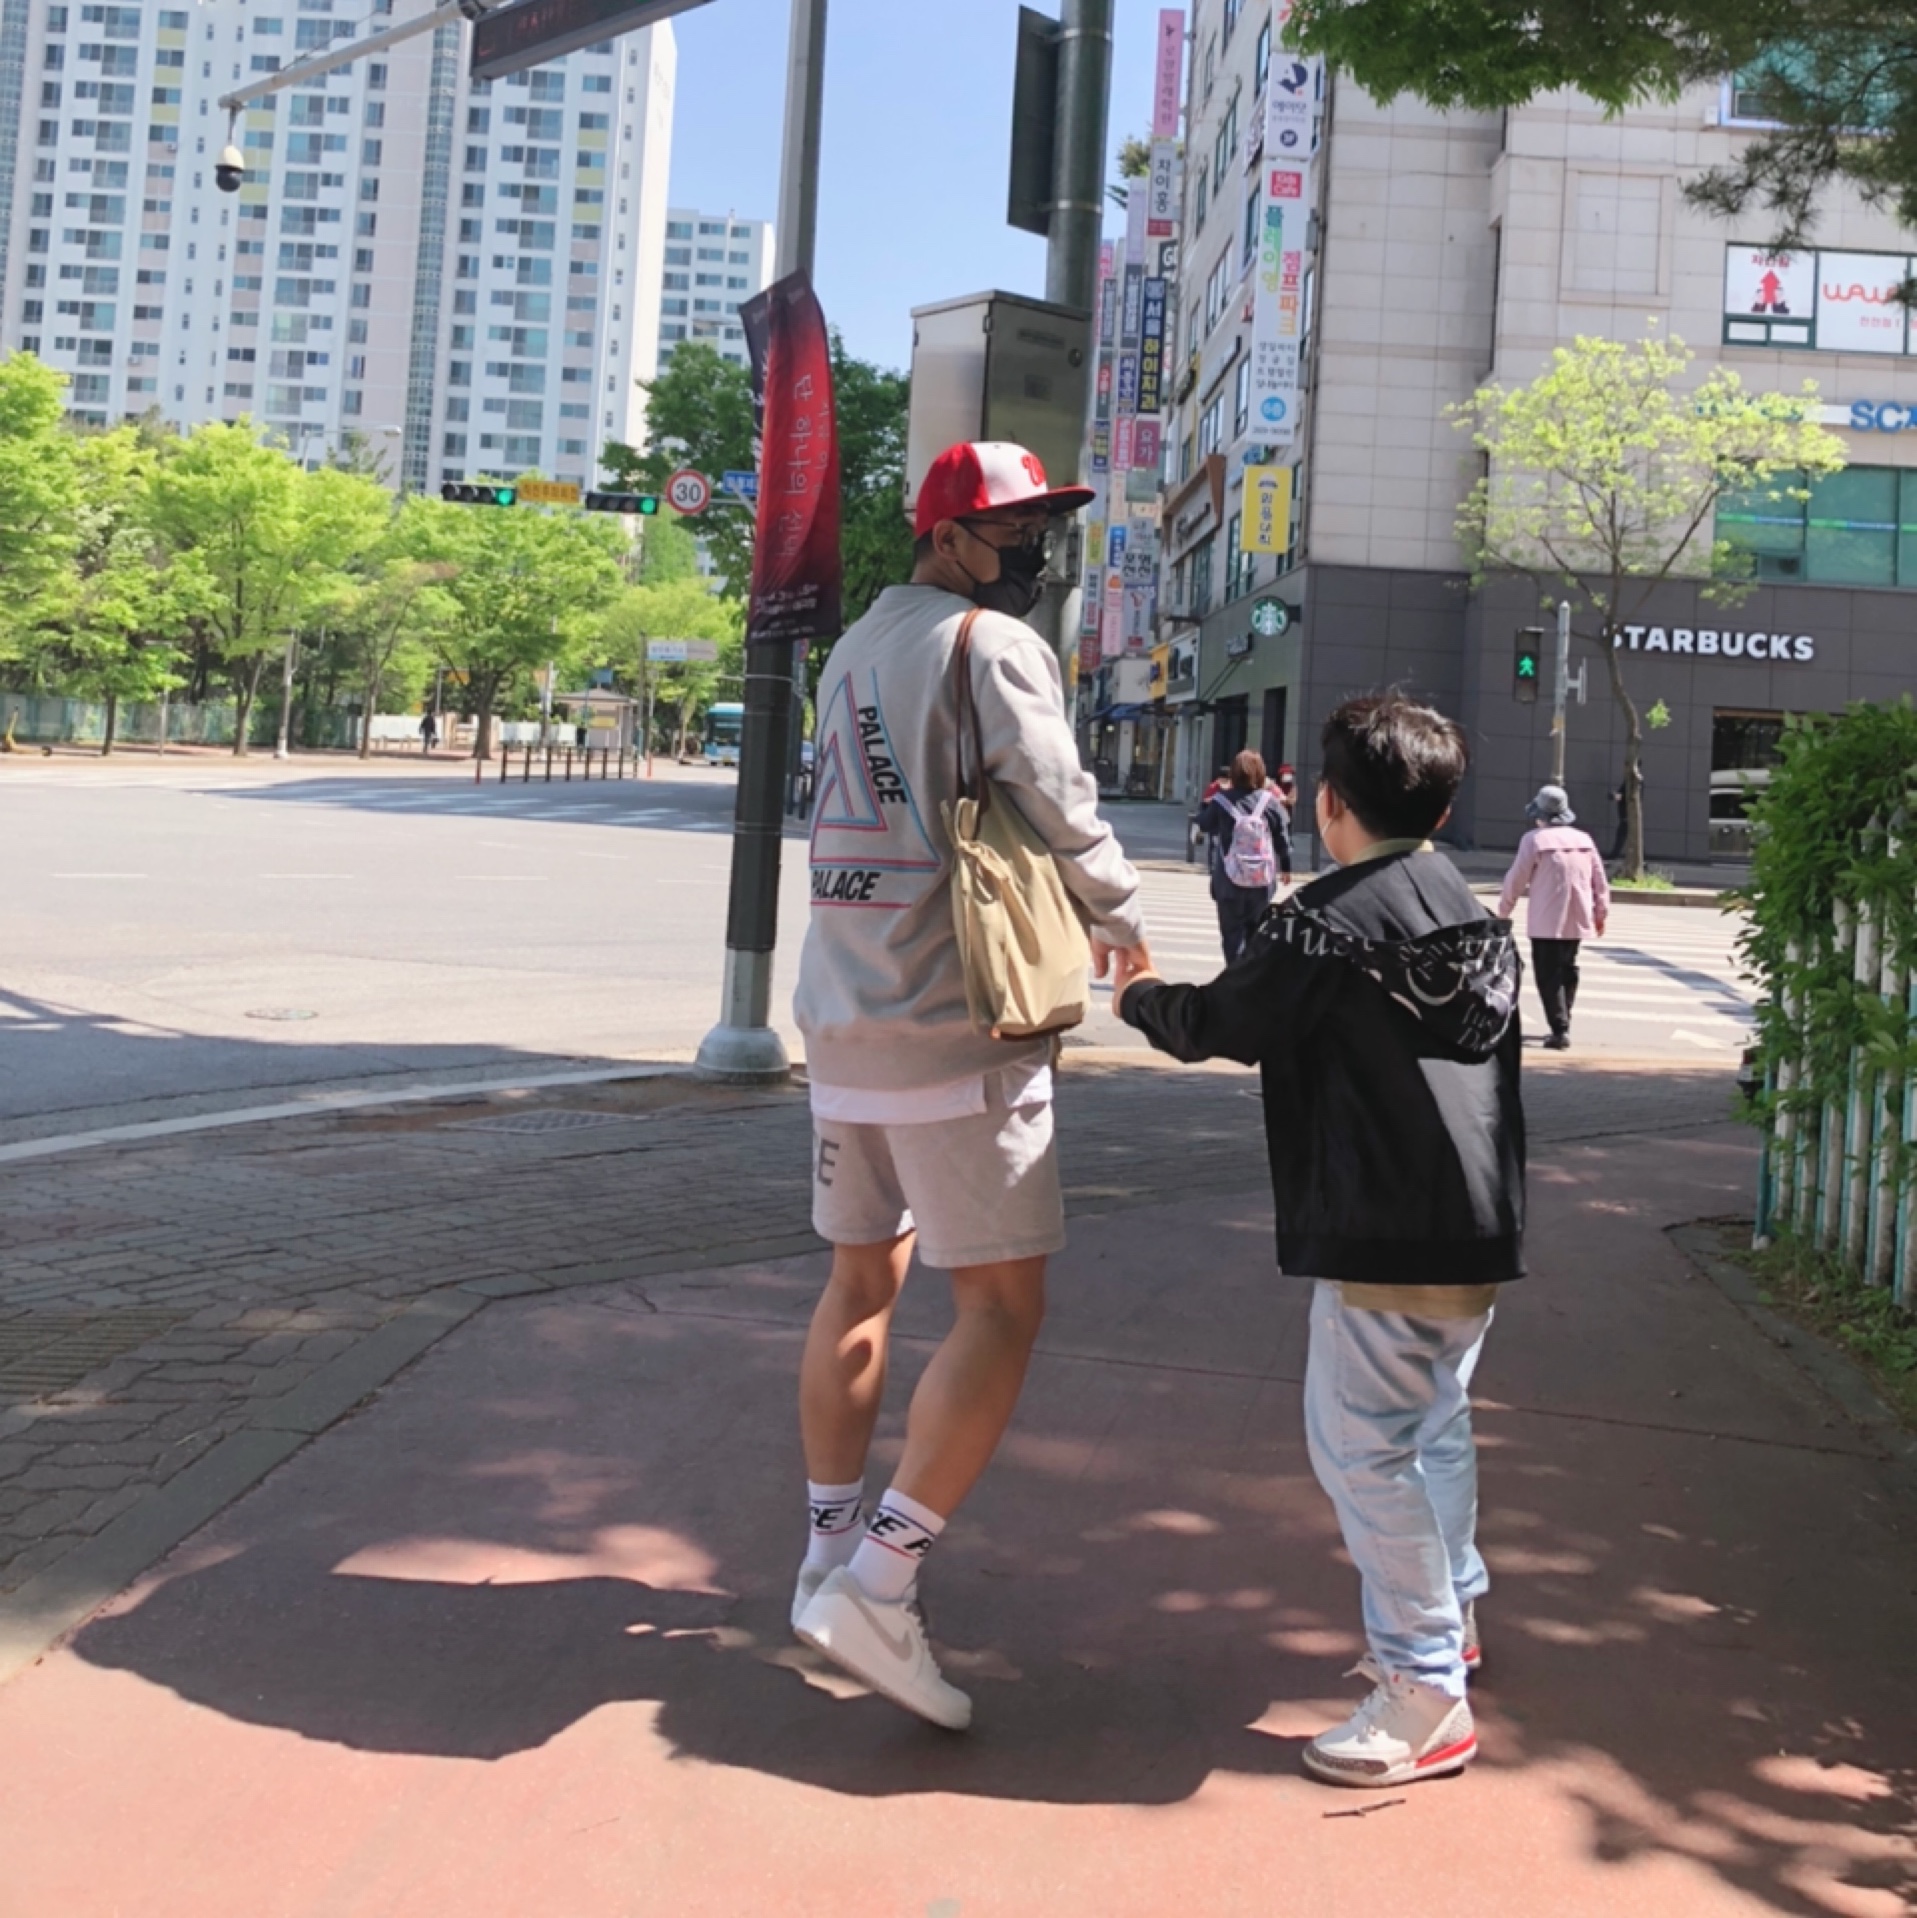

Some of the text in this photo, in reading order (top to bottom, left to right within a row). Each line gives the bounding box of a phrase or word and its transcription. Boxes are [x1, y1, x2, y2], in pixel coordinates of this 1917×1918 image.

[1139, 429, 1154, 462] 요가
[676, 482, 702, 503] 30
[858, 705, 908, 804] PALACE
